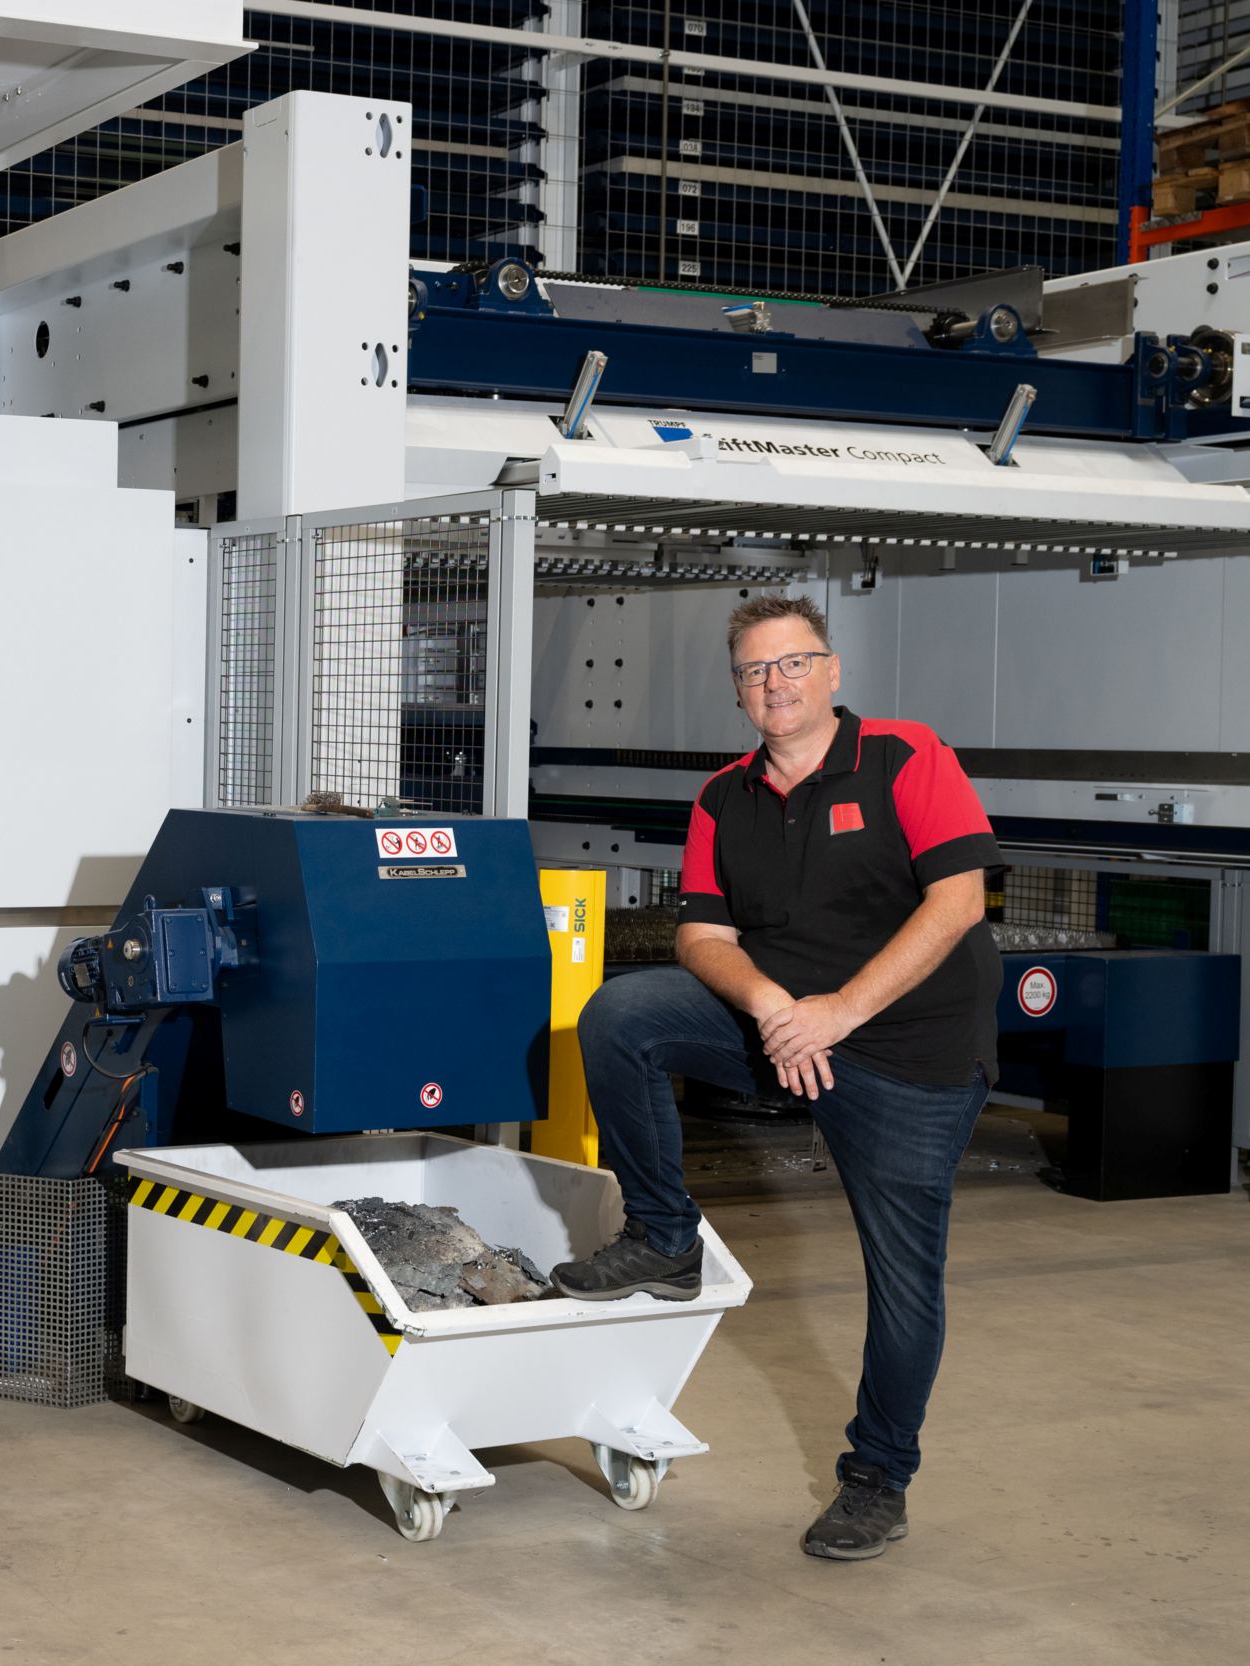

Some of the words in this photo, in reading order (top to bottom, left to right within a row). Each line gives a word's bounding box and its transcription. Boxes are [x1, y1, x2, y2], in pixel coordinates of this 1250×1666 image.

[687, 23, 703, 33] 070
[682, 183, 698, 194] 072
[647, 419, 686, 428] TRUMPF
[846, 446, 946, 465] Compact
[574, 898, 587, 933] SICK
